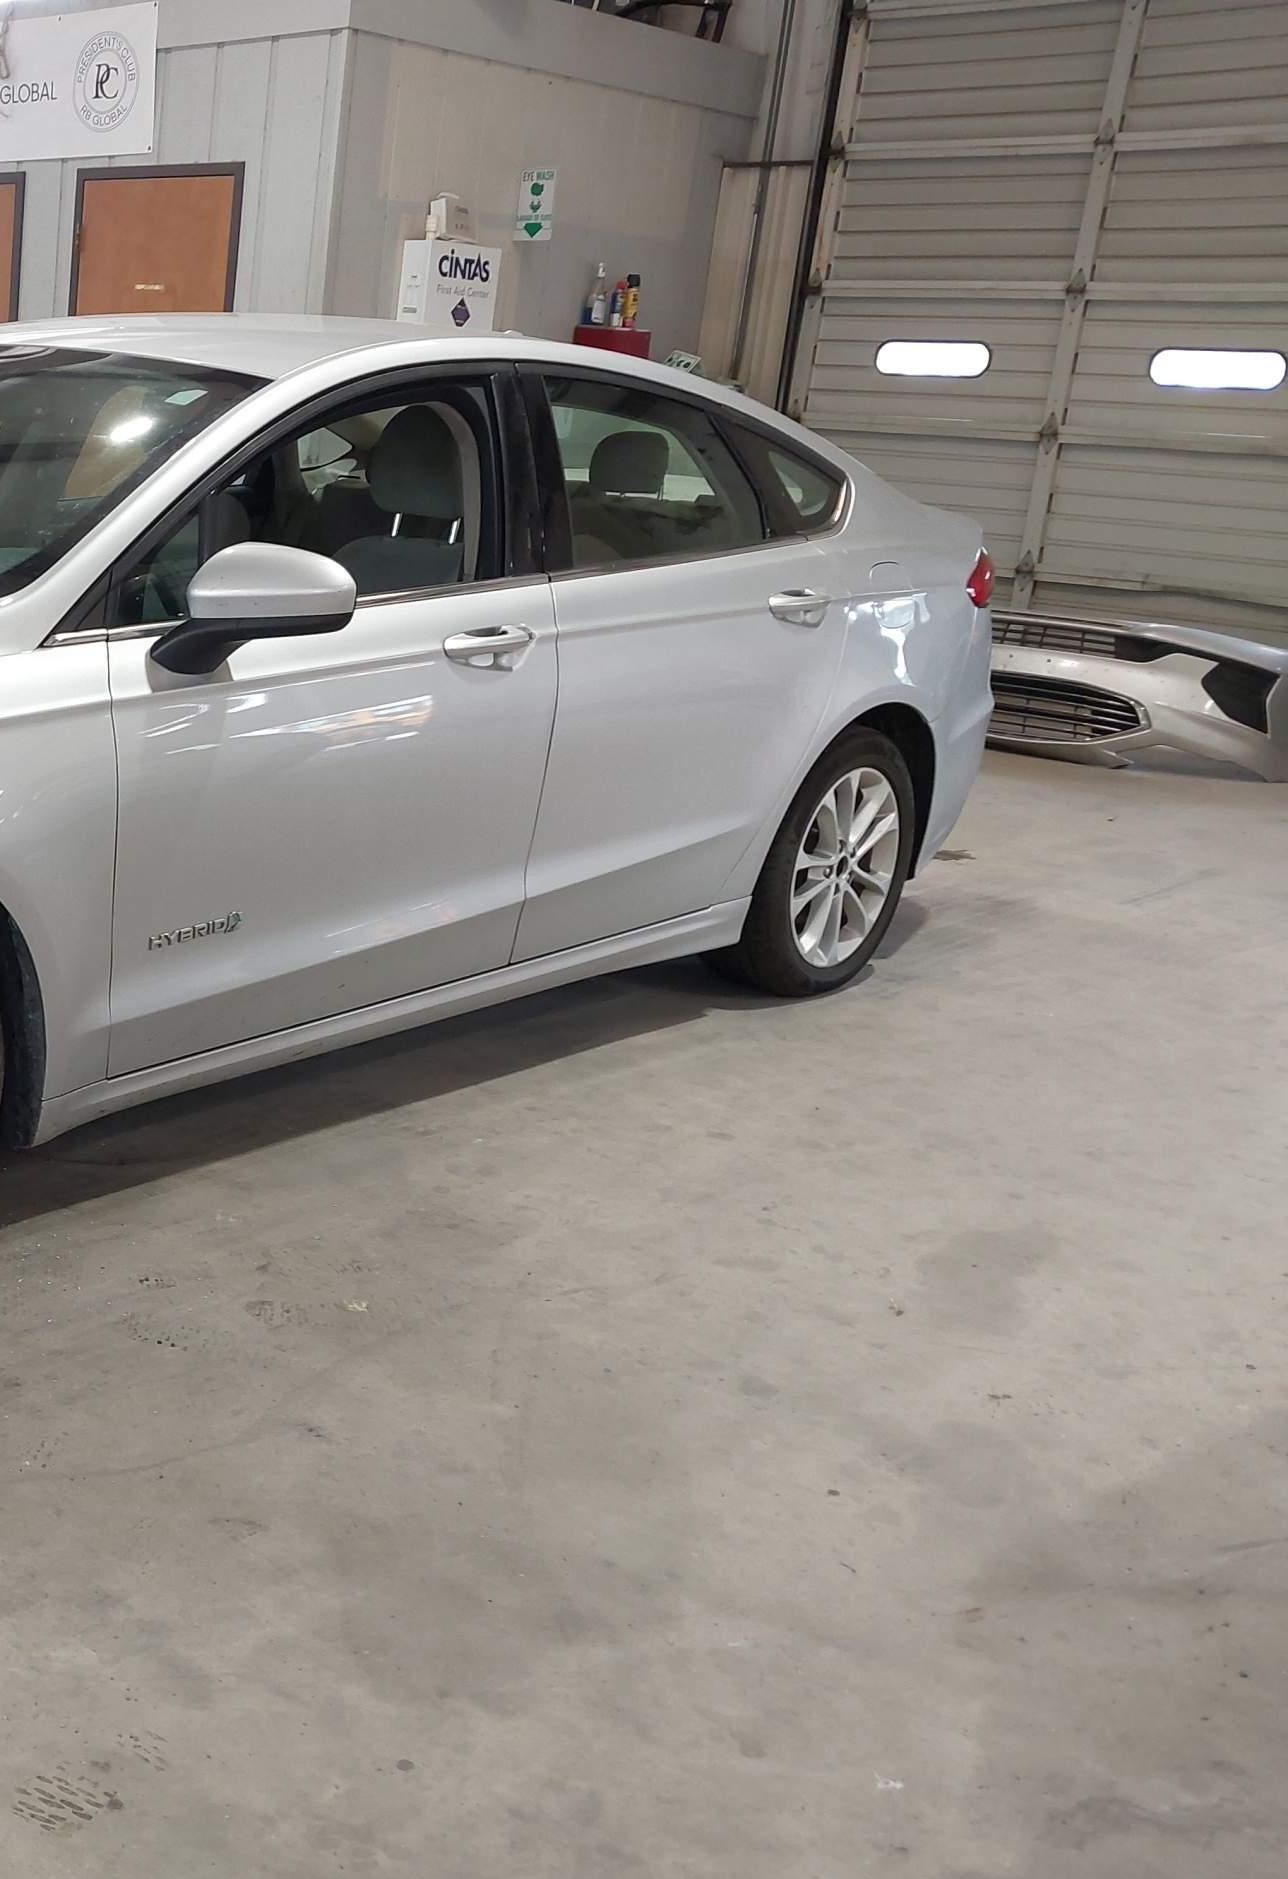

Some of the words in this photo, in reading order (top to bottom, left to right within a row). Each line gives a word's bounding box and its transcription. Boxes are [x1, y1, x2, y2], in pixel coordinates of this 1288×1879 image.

[121, 47, 136, 82] CLUB
[0, 81, 58, 105] GLOBAL
[80, 104, 91, 121] RB
[92, 105, 128, 127] GLOBAL
[438, 248, 490, 283] CINTAS
[147, 918, 226, 951] HYBRID
